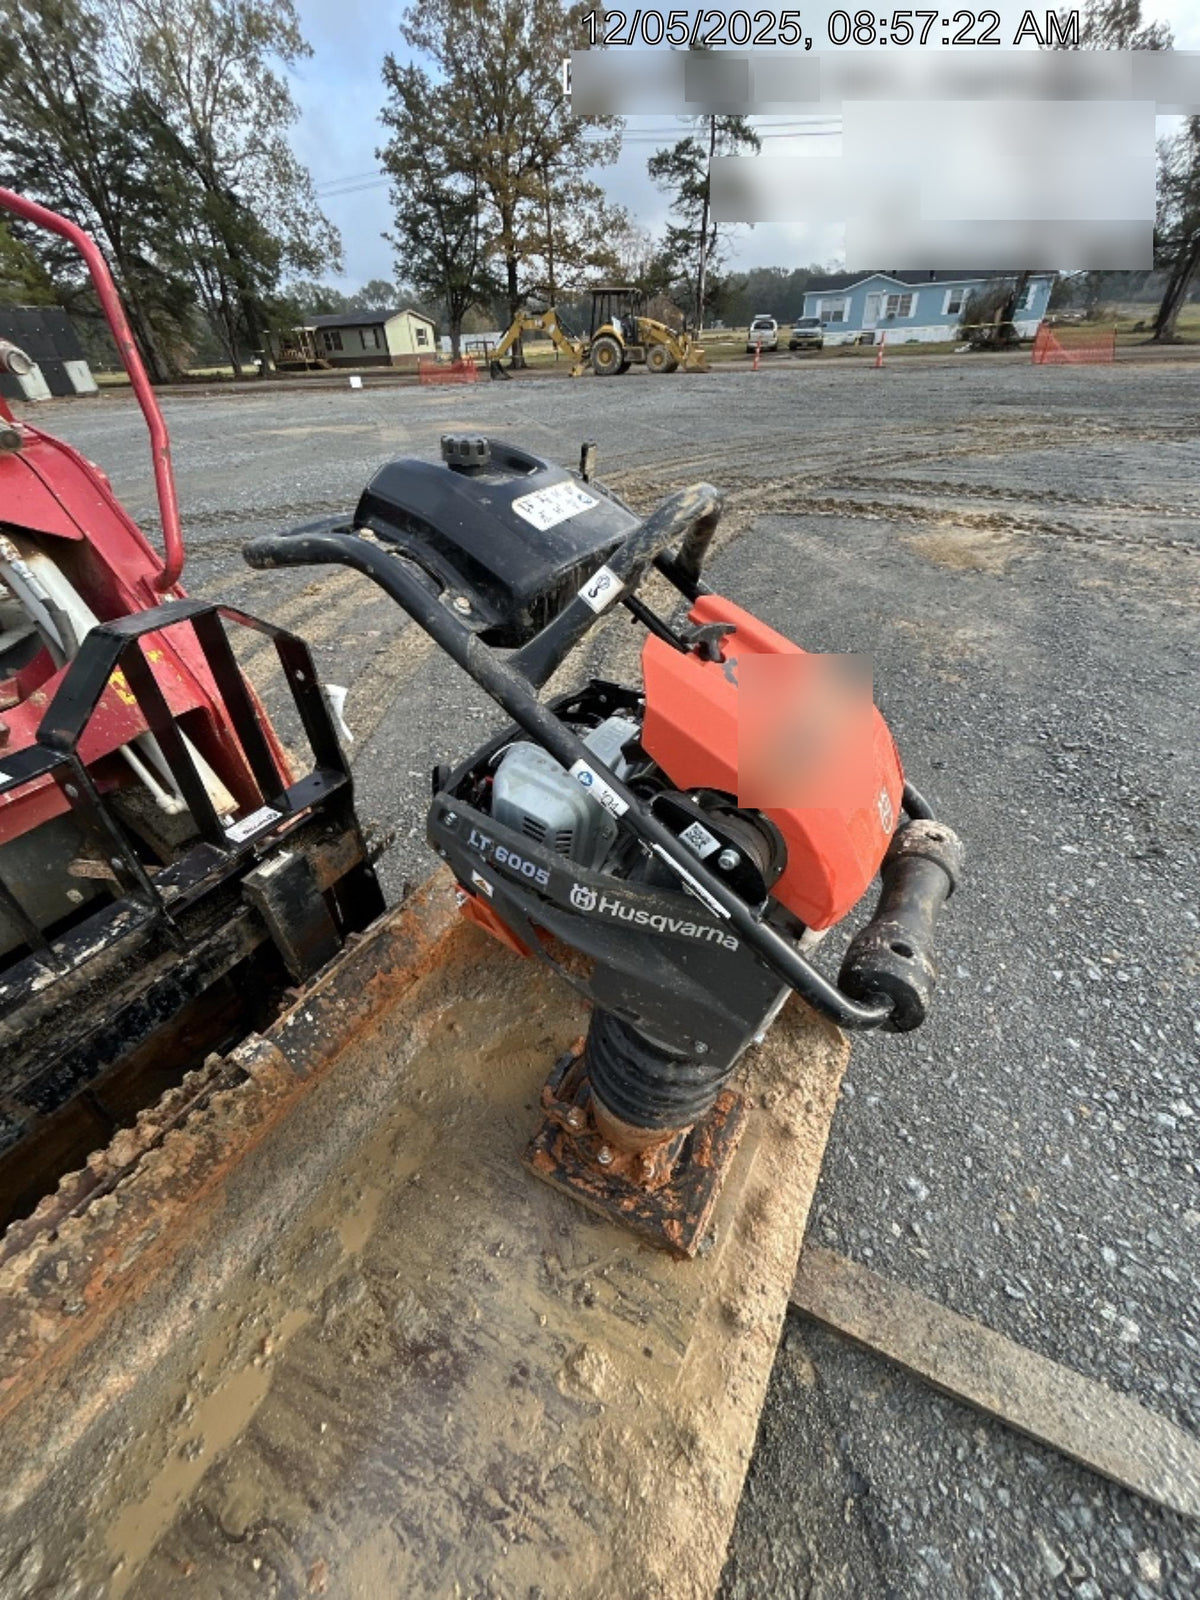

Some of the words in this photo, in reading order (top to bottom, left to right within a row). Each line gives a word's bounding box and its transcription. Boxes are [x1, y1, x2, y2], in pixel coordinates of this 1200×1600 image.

[467, 829, 492, 851] LT
[495, 845, 550, 886] 6005
[598, 897, 740, 952] Husqvarna
